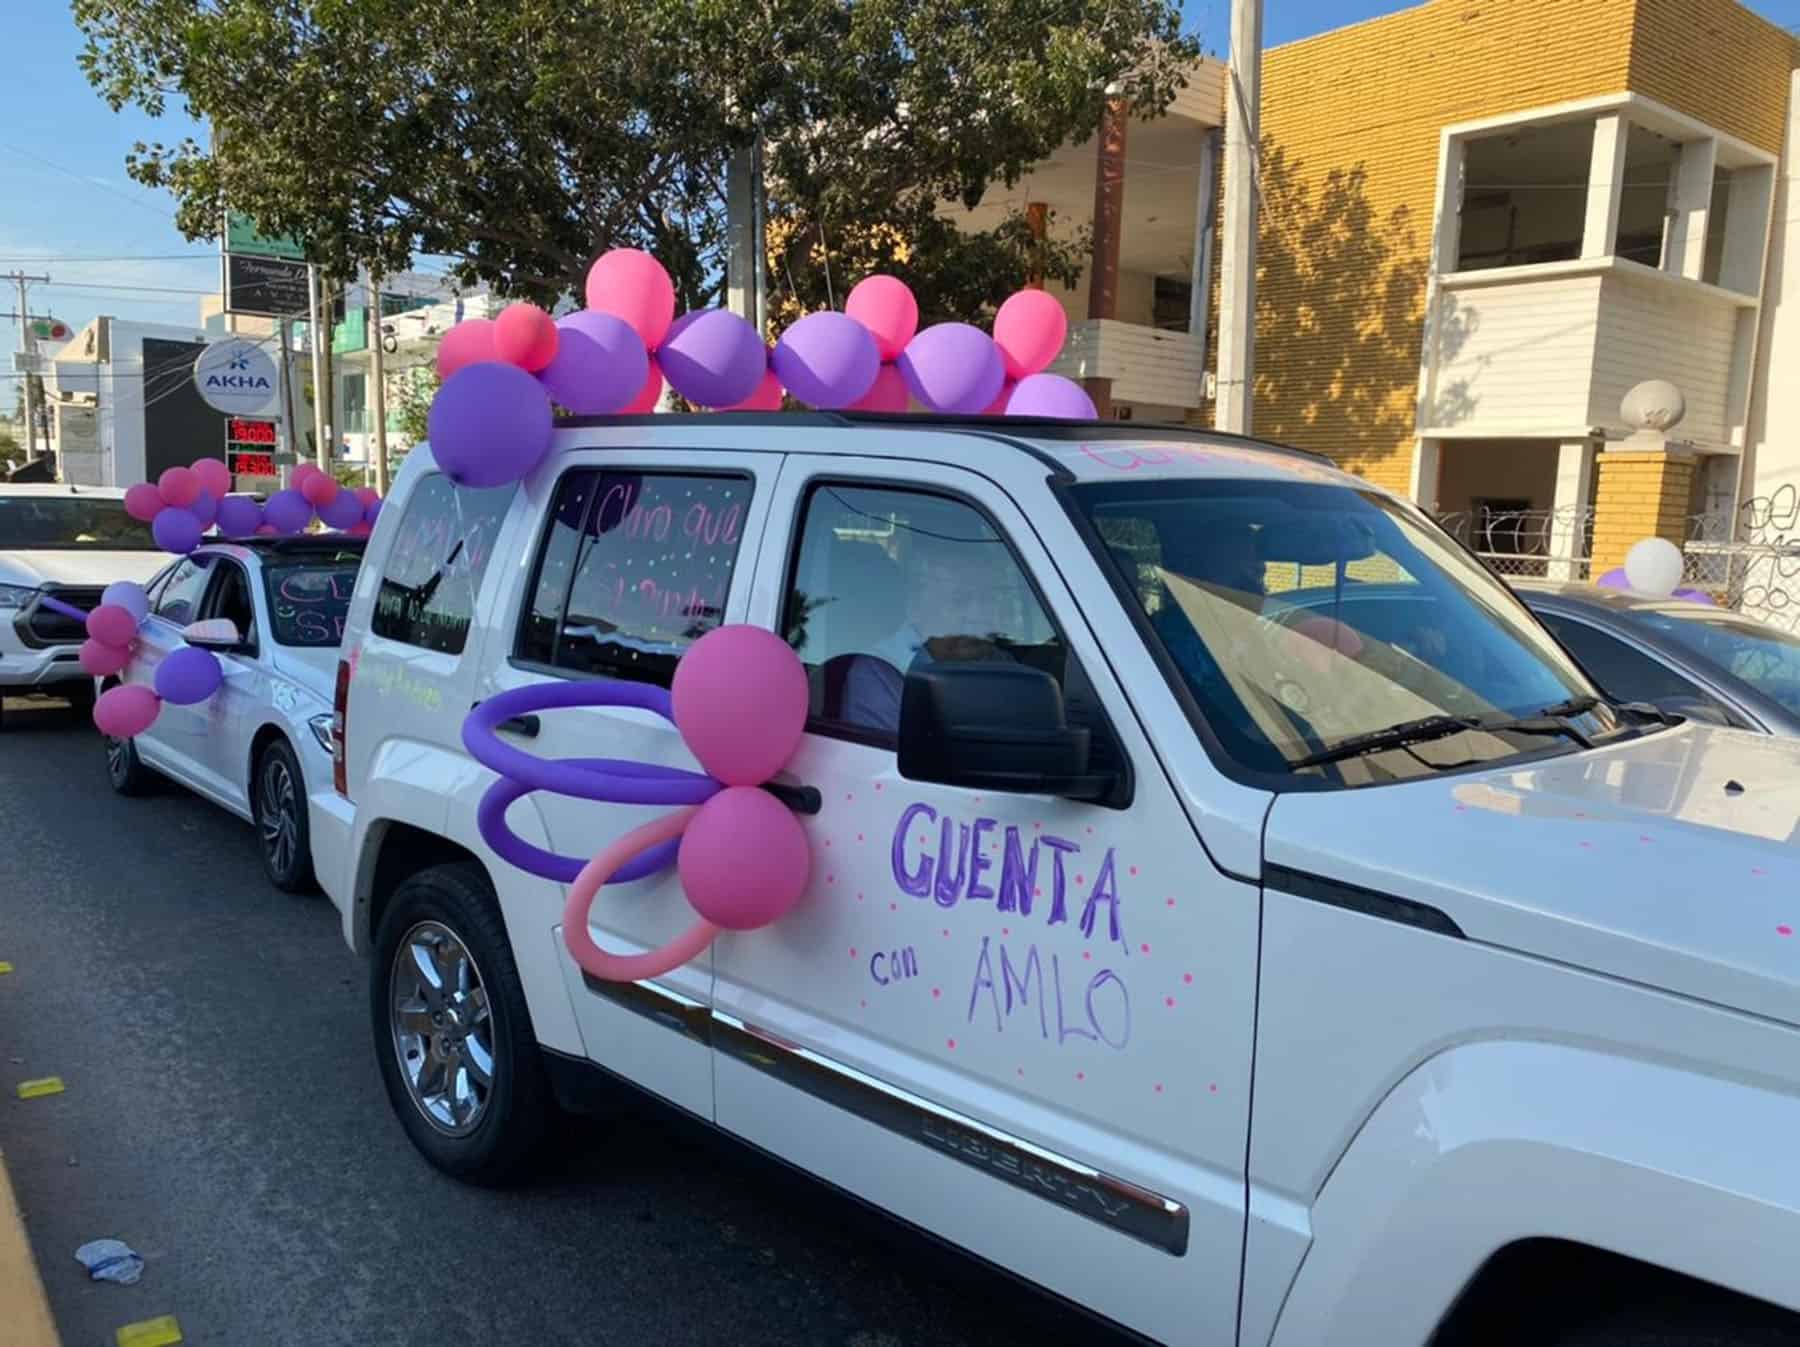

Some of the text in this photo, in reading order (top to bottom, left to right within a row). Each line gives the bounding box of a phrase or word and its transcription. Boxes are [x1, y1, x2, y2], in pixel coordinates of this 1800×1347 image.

[205, 374, 271, 390] AKHA
[870, 935, 1131, 1050] con AMLO
[920, 1114, 1129, 1217] LIBERTY
